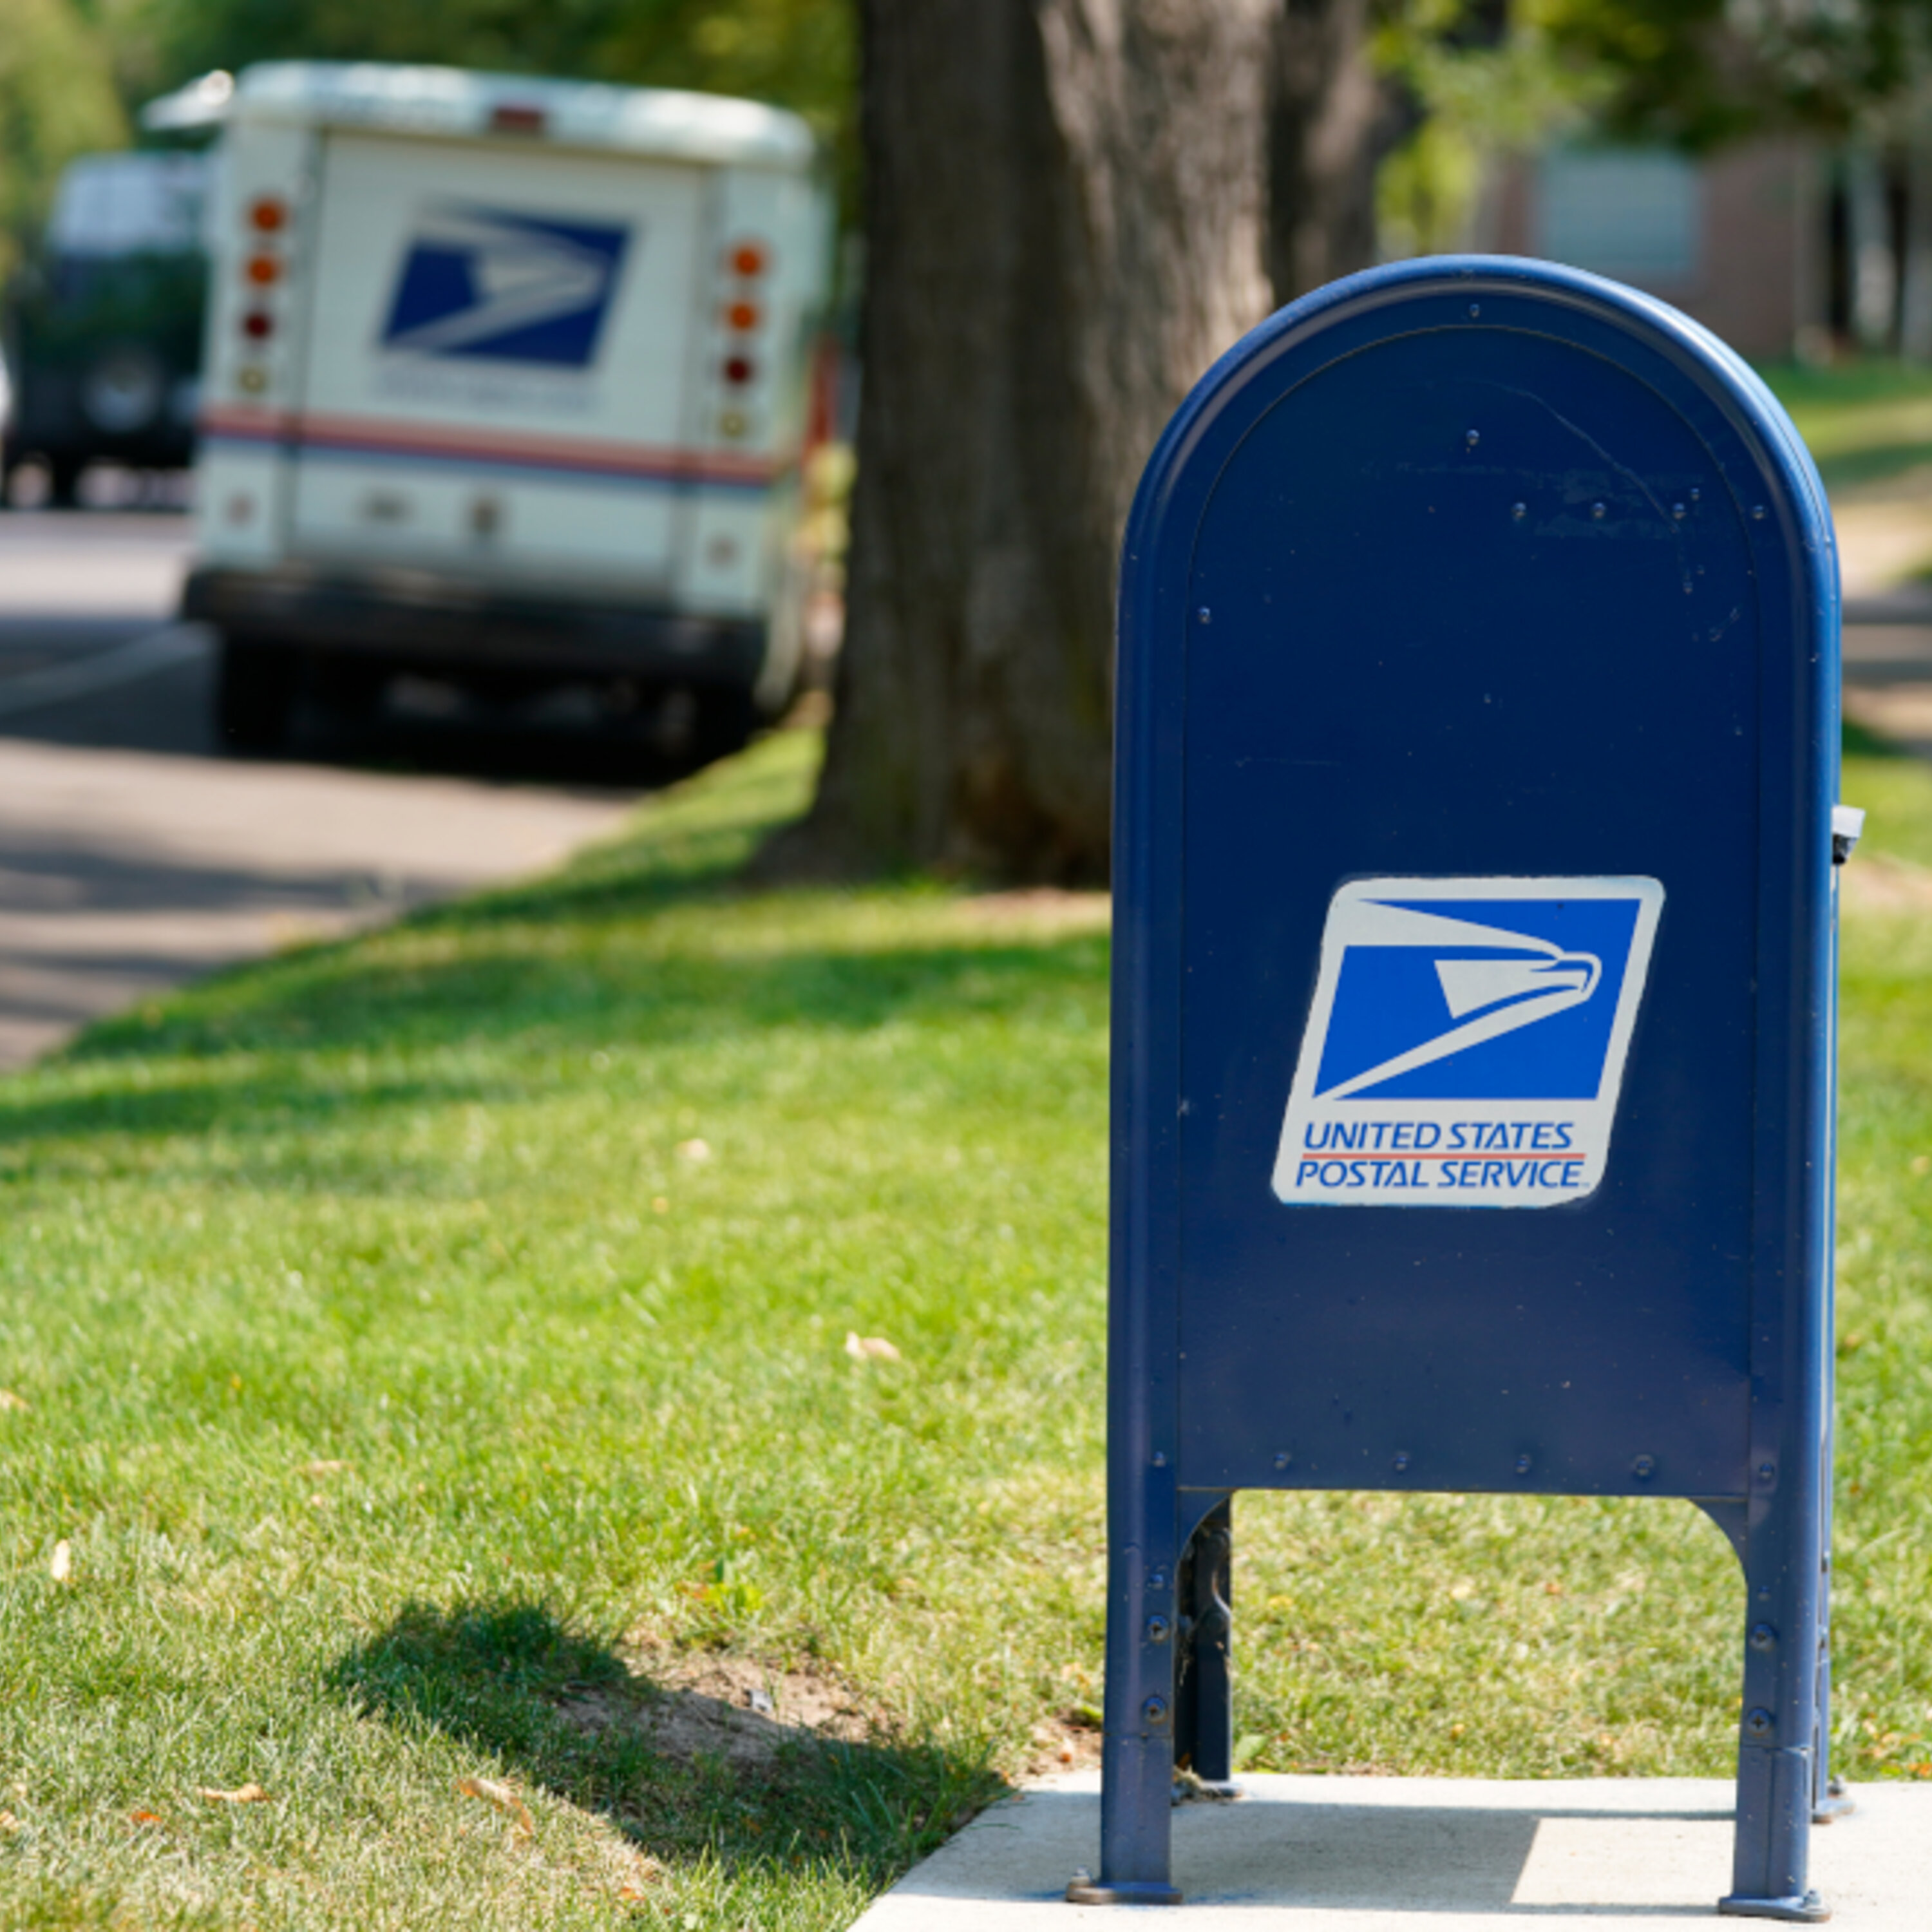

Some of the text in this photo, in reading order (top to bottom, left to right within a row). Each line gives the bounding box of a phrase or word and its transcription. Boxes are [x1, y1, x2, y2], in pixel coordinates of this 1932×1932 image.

[1303, 1122, 1574, 1150] UNITED STATES
[1295, 1160, 1584, 1188] POSTAL SERVICE
